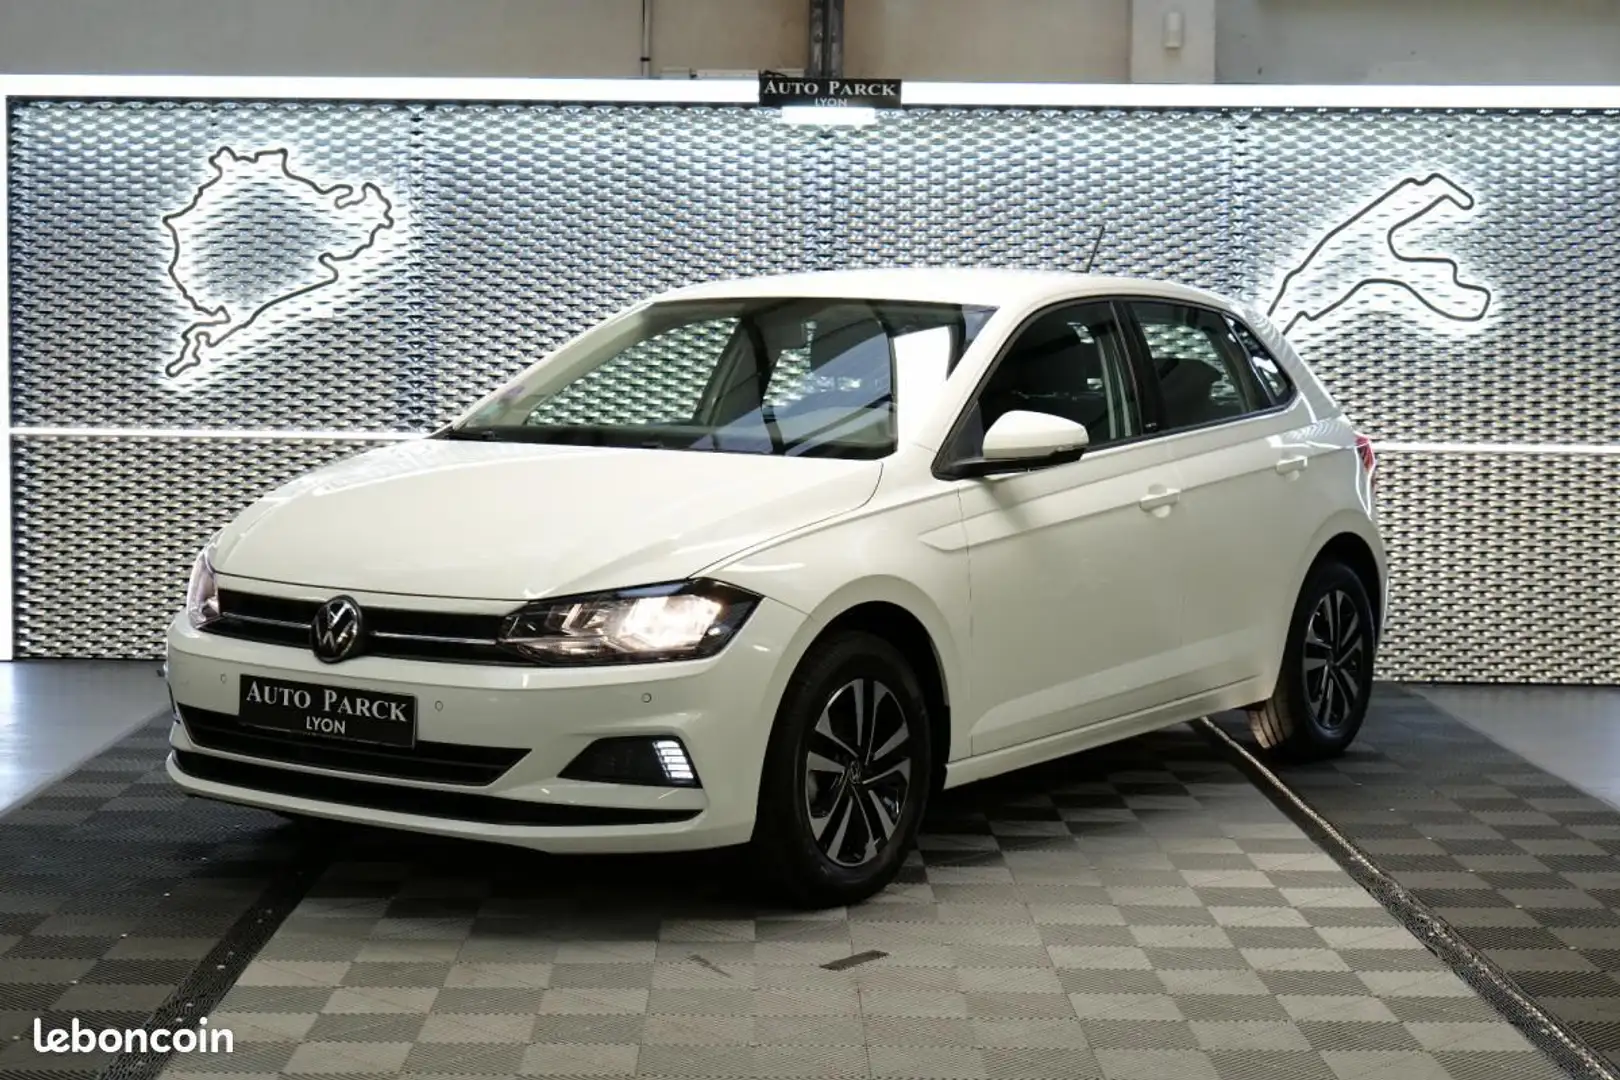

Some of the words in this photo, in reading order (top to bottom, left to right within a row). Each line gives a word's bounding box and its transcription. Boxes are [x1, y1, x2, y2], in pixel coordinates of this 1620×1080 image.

[764, 80, 819, 95] AUTO
[828, 81, 896, 96] PARCK
[815, 98, 848, 107] LYON
[246, 680, 311, 709] AUTO
[323, 689, 407, 722] PARCK
[305, 715, 346, 734] LYON
